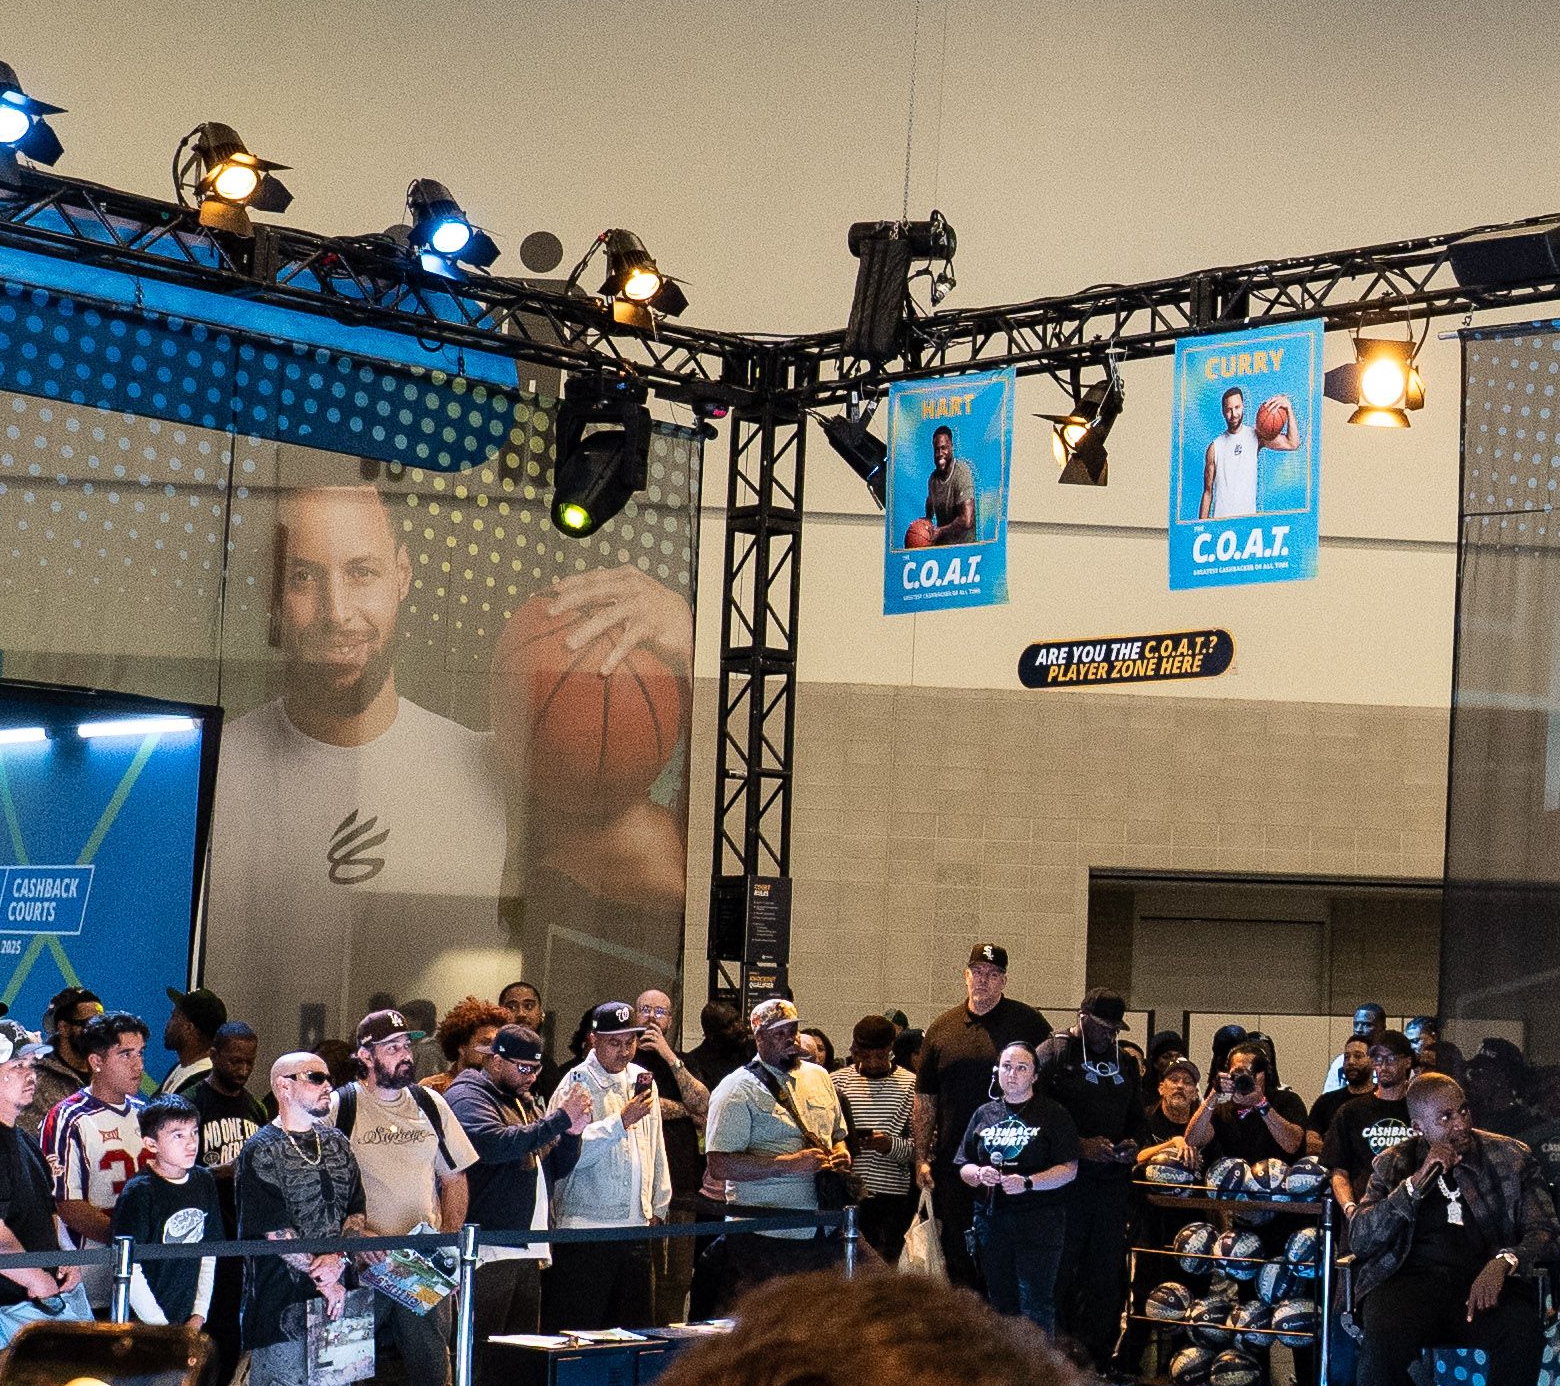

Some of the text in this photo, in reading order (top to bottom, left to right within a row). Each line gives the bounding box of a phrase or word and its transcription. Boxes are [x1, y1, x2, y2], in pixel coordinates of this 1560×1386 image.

[1203, 348, 1285, 381] CURRY
[921, 393, 976, 419] HART
[1192, 525, 1290, 564] C.O.A.T.
[902, 555, 981, 590] C.O.A.T.
[1035, 635, 1218, 667] ARE YOU THE C.O.A.T.?
[1047, 655, 1204, 683] PLAYER ZONE HERE
[12, 877, 80, 899] CASHBACK
[7, 901, 57, 922] COURTS
[0, 940, 22, 955] 2025
[203, 1120, 221, 1153] NO
[221, 1117, 244, 1143] ONE
[980, 1127, 1041, 1137] CASHBACK
[985, 1136, 1030, 1146] COURTS
